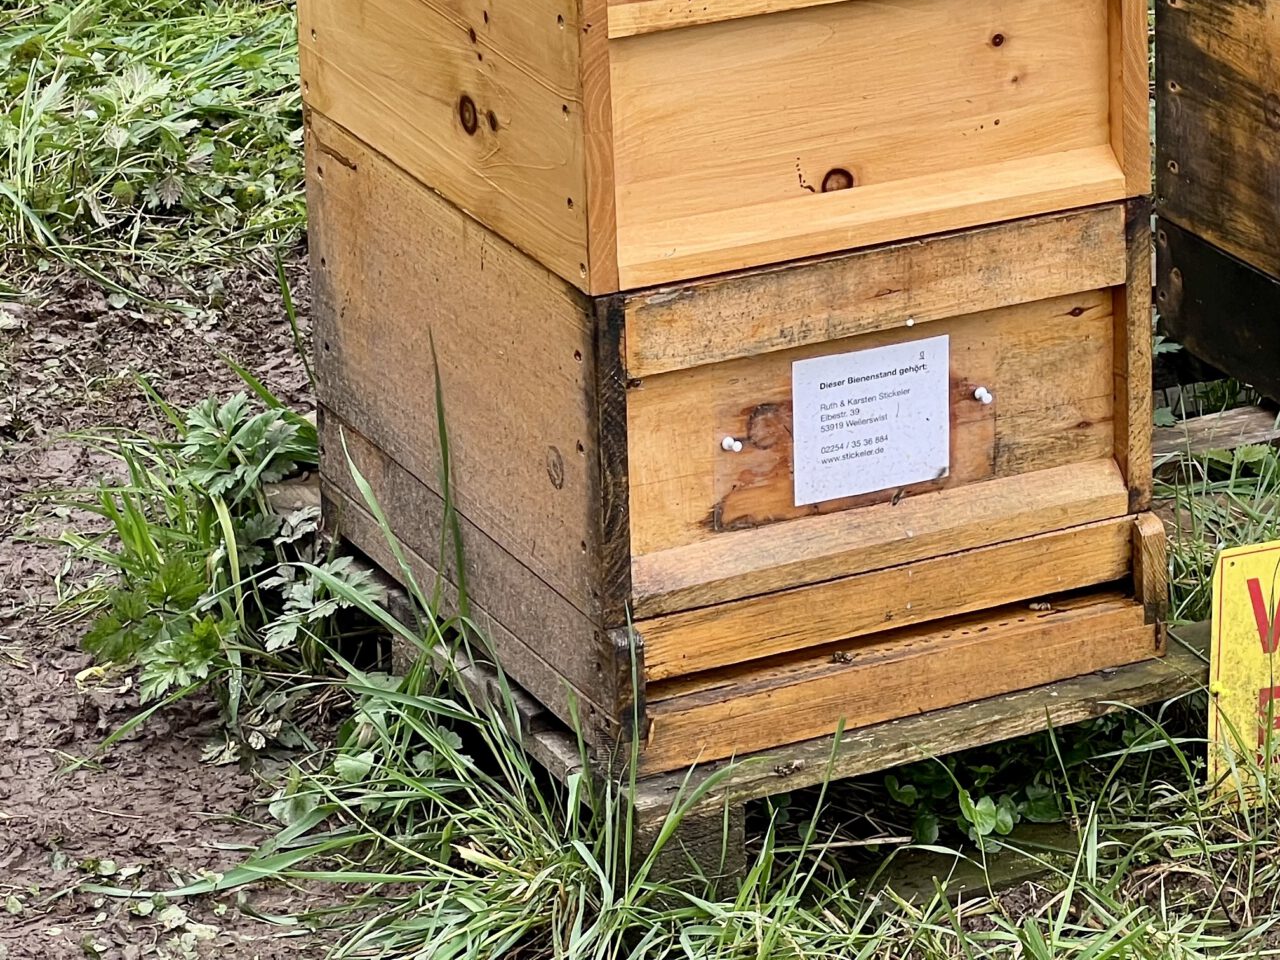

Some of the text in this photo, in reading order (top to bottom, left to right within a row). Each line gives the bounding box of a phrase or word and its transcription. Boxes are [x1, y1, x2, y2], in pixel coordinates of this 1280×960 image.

[819, 363, 928, 390] Dieser Bienenstand gehört:
[820, 402, 838, 411] Ruth
[847, 395, 877, 406] Karsten
[878, 388, 911, 401] Stickeler
[820, 407, 860, 422] Elbestr. 39
[820, 413, 888, 433] 53919 Weilerswist
[820, 443, 844, 454] 02254
[851, 439, 861, 448] 35
[863, 437, 873, 446] 36
[820, 447, 885, 464] www.stickeler.de
